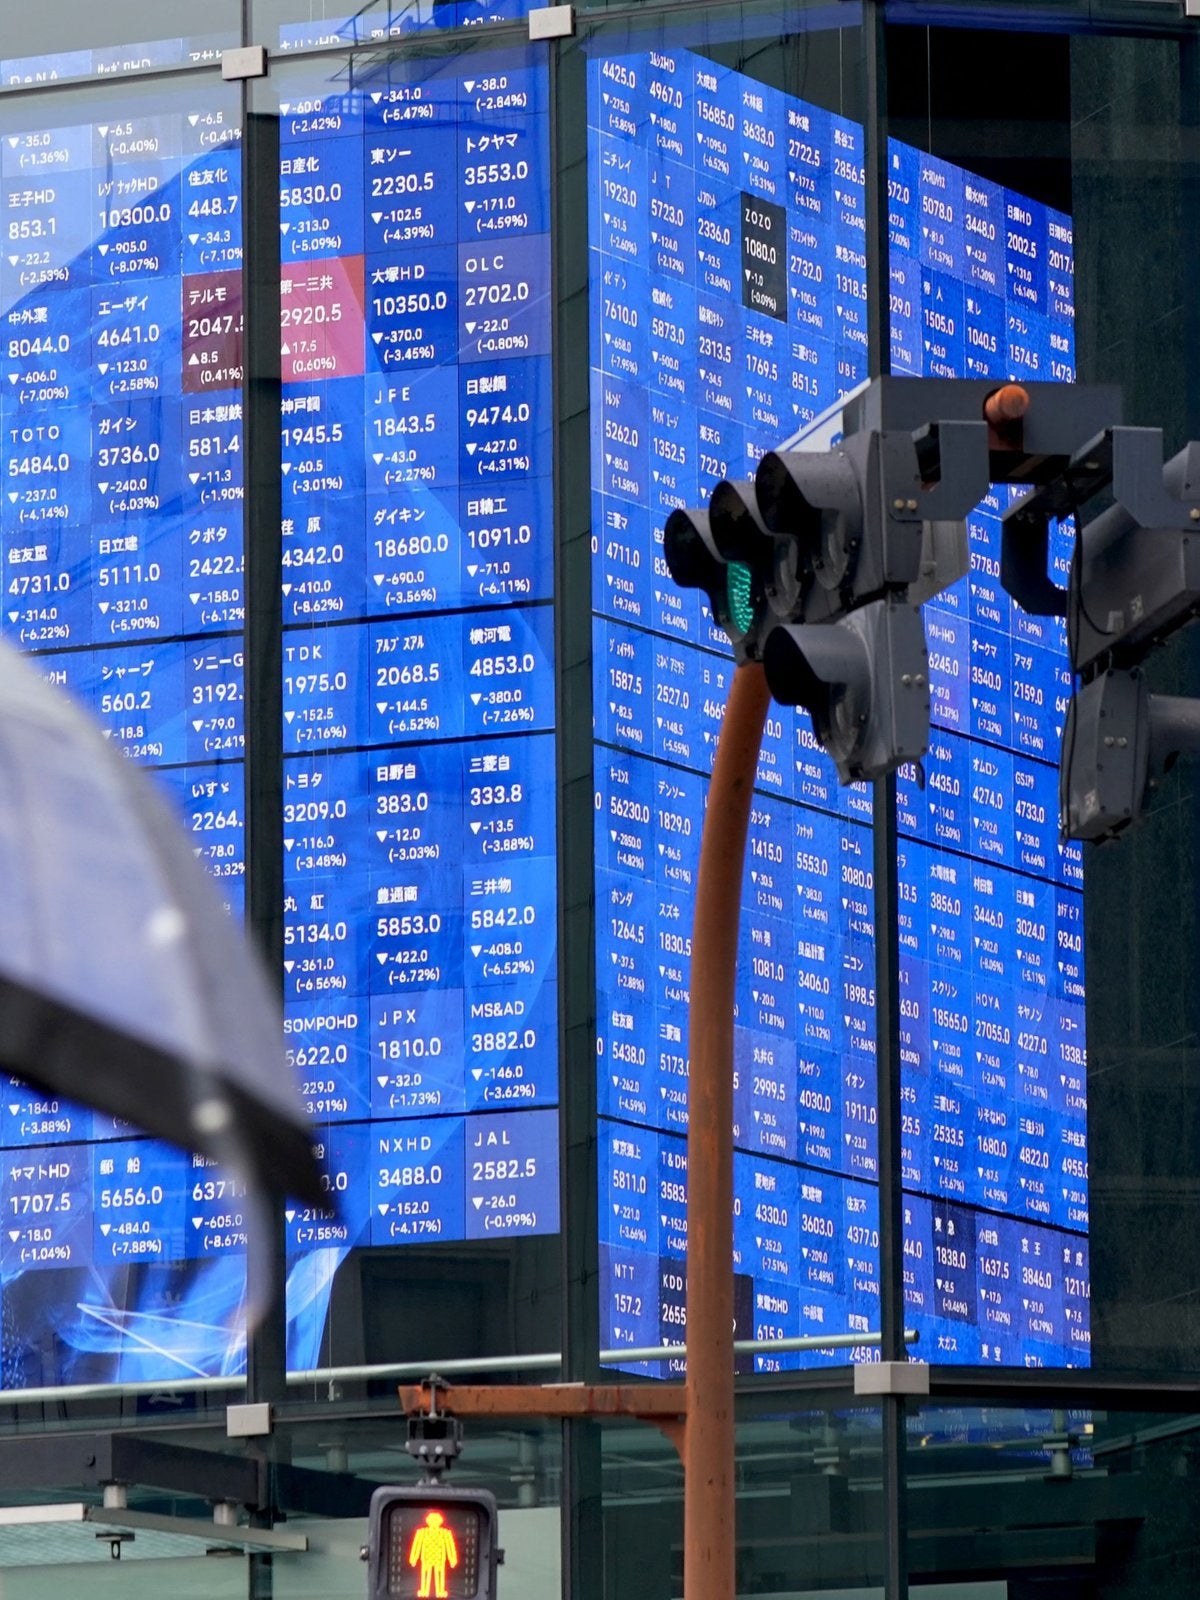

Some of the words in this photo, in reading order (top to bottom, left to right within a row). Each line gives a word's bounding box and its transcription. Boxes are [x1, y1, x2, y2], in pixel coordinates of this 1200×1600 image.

[603, 60, 635, 88] 4425.0
[650, 81, 682, 108] 4967.0
[383, 104, 432, 123] (-5.47%)
[467, 134, 517, 153] トクヤマ
[743, 120, 774, 147] 3633.0
[371, 148, 411, 164] 東ソー
[604, 152, 631, 172] ニチレイ
[789, 139, 819, 166] 2722.5
[281, 157, 319, 175] 日産化
[465, 161, 527, 185] 3553.0
[835, 159, 865, 185] 2856.5
[188, 168, 227, 186] 住友化
[372, 172, 433, 196] 2230.5
[9, 189, 55, 207] 王子HD
[280, 184, 341, 207] 5830.0
[604, 180, 636, 207] 1923.0
[100, 204, 170, 228] 10300.0
[188, 196, 237, 218] 448.7
[652, 199, 683, 226] 5723.0
[923, 196, 952, 222] 5078.0
[9, 218, 55, 239] 853.1
[477, 214, 527, 232] (-4.59%)
[746, 208, 771, 230] ZOZO
[384, 224, 433, 243] (-4.39%)
[698, 218, 729, 245] 2336.0
[745, 237, 776, 264] 1080.0
[1008, 232, 1036, 258] 2002.5
[20, 267, 69, 285] (-2.53%)
[110, 257, 158, 275] (-8.07%)
[281, 275, 332, 294] 第一三共
[466, 283, 528, 306] 2702.0
[99, 296, 148, 315] エーザイ
[189, 288, 226, 305] テルモ
[373, 292, 446, 316] 10350.0
[9, 307, 47, 325] 中外薬
[281, 304, 341, 327] 2920.5
[605, 300, 637, 327] 7610.0
[98, 324, 159, 346] 4641.0
[653, 318, 684, 345] 5873.0
[9, 335, 69, 357] 8044.0
[384, 345, 434, 363] (-3.45%)
[478, 335, 528, 353] (-0.80%)
[293, 356, 335, 374] (0.60%)
[1010, 344, 1038, 369] 1574.5
[20, 386, 68, 404] (-7.00%)
[110, 376, 158, 394] (-2.58%)
[374, 414, 434, 436] 1843.5
[467, 404, 529, 426] 9474.0
[99, 418, 136, 434] ガイシ
[282, 424, 342, 446] 1945.5
[606, 420, 638, 447] 5262.0
[99, 444, 159, 466] 3736.0
[190, 435, 239, 456] 581.4
[9, 454, 68, 476] 5484.0
[479, 456, 529, 474] (-4.31%)
[701, 455, 726, 478] 722.9
[374, 508, 425, 525] ダイキン
[468, 498, 507, 516] 日精工
[100, 535, 137, 554] 日立建
[189, 527, 227, 544] クボタ
[375, 534, 448, 557] 18680.0
[469, 526, 530, 548] 1091.0
[8, 545, 47, 563] 住友重
[282, 545, 343, 567] 4342.0
[9, 573, 69, 594] 4731.0
[99, 564, 160, 586] 5111.0
[480, 579, 529, 596] (-6.11%)
[111, 616, 159, 633] (-5.90%)
[470, 626, 511, 644] 横河電
[103, 660, 154, 679] シャープ
[377, 663, 439, 686] 2068.5
[470, 654, 534, 676] 4853.0
[285, 672, 346, 694] 1975.0
[610, 669, 641, 694] 1587.5
[102, 691, 151, 712] 560.2
[389, 716, 439, 734] (-6.52%)
[483, 707, 534, 725] (-7.26%)
[377, 764, 415, 781] 日野自
[470, 755, 509, 772] 三菱自
[973, 758, 998, 776] オムロン
[286, 773, 322, 789] トヨタ
[659, 780, 685, 798] デンソー
[930, 772, 959, 795] 4435.0
[377, 793, 427, 814] 383.0
[471, 784, 521, 805] 333.8
[284, 800, 346, 822] 3209.0
[611, 796, 649, 823] 56230.0
[1016, 800, 1044, 823] 4733.0
[842, 838, 860, 855] ローム
[471, 878, 511, 895] 三井物
[842, 866, 873, 889] 3080.0
[612, 889, 632, 906] ホンダ
[472, 906, 534, 928] 5842.0
[659, 903, 679, 919] スズキ
[285, 922, 346, 944] 5134.0
[378, 914, 440, 936] 5853.0
[612, 919, 644, 943] 1264.5
[844, 955, 863, 971] ニコン
[799, 971, 829, 994] 3406.0
[933, 981, 957, 997] スクリン
[472, 1001, 524, 1018] MS&AD
[976, 993, 999, 1009] HOYA
[284, 1015, 357, 1033] SOMPOHD
[933, 1008, 967, 1032] 18565.0
[1060, 1017, 1077, 1030] リコー
[472, 1030, 535, 1052] 3882.0
[976, 1020, 1010, 1044] 27055.0
[379, 1038, 441, 1059] 1810.0
[754, 1077, 785, 1100] 2999.5
[846, 1073, 865, 1088] イオン
[485, 1084, 535, 1101] (-3.62%)
[978, 1136, 1006, 1157] 1680.0
[10, 1164, 69, 1181] ヤマトHD
[379, 1166, 441, 1187] 3488.0
[473, 1159, 535, 1180] 2582.5
[614, 1170, 646, 1193] 5811.0
[10, 1193, 70, 1214] 1707.5
[102, 1186, 162, 1208] 5656.0
[485, 1213, 536, 1229] (-0.99%)
[847, 1226, 878, 1247] 4377.0
[112, 1239, 161, 1256] (-7.88%)
[980, 1257, 1009, 1279] 1637.5
[1023, 1267, 1051, 1289] 3846.0
[615, 1294, 641, 1315] 157.2
